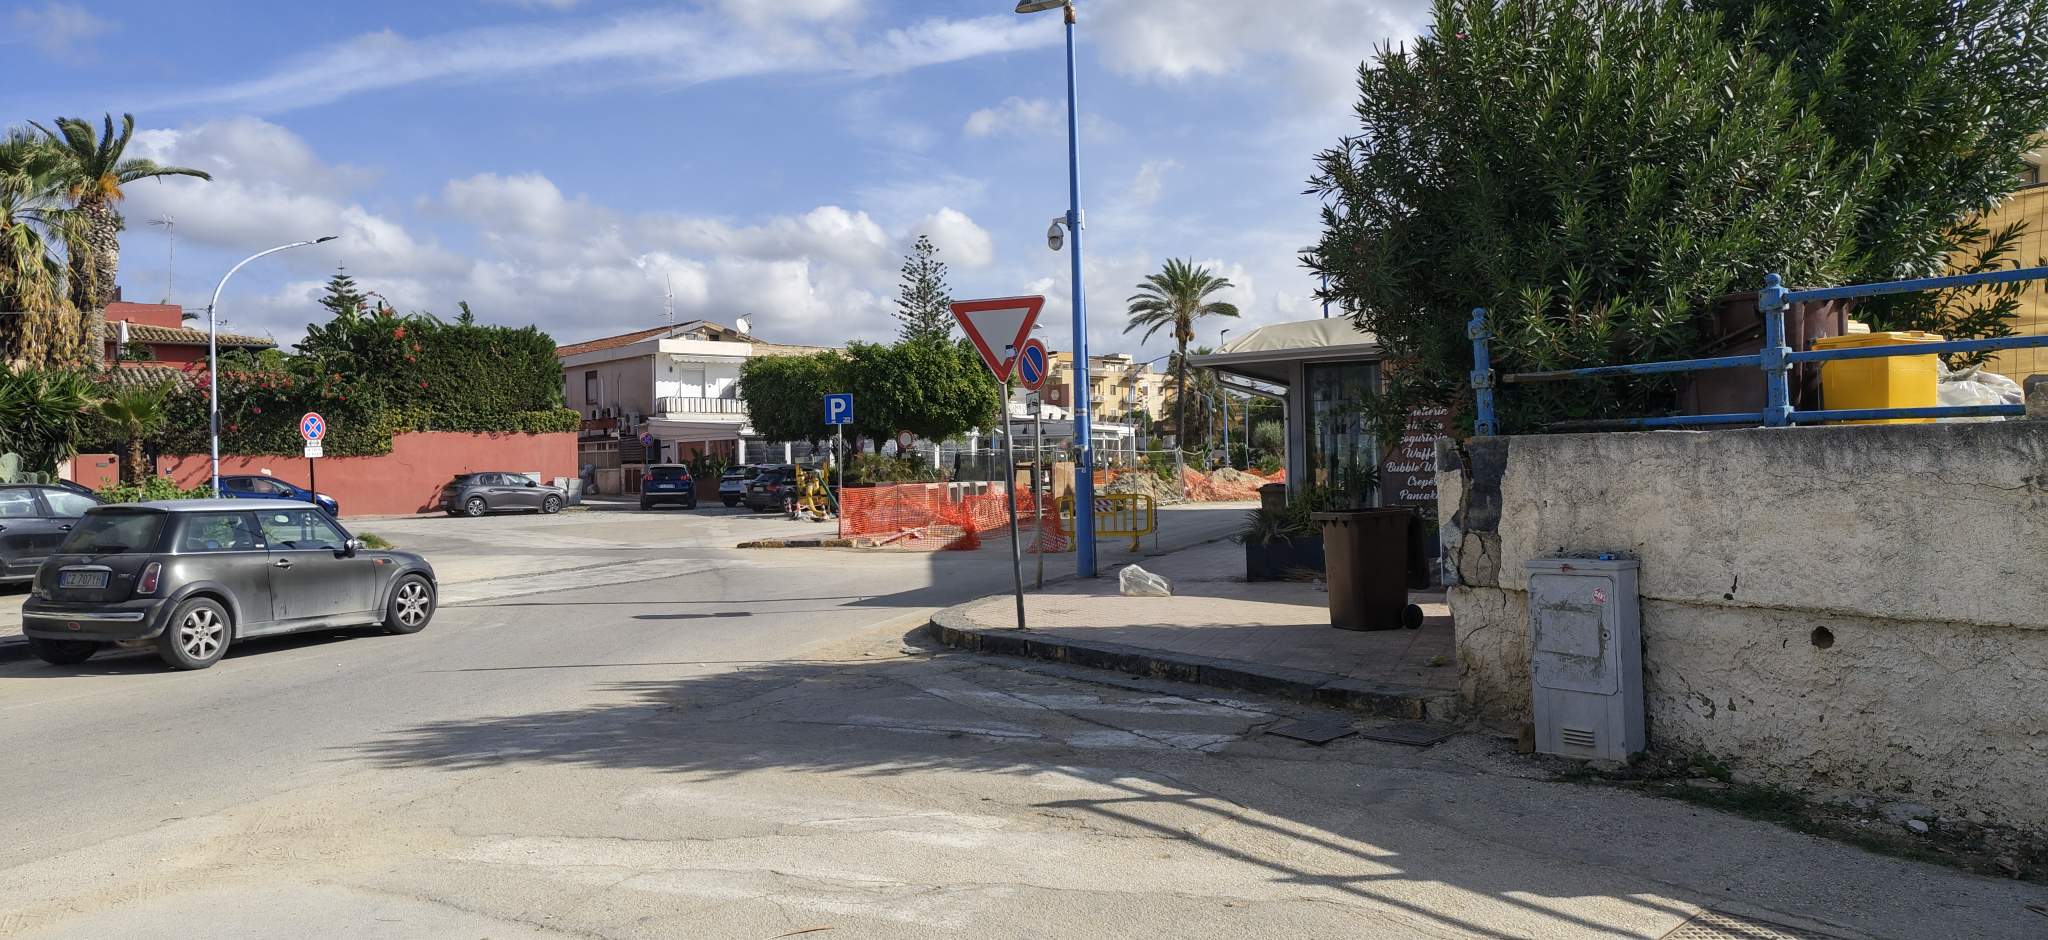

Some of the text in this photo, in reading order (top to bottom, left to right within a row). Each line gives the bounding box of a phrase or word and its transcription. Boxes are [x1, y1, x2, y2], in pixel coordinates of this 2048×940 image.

[831, 398, 846, 421] P
[1401, 447, 1437, 460] Waffe
[1386, 461, 1420, 473] Bubble
[1400, 489, 1439, 500] Pancak
